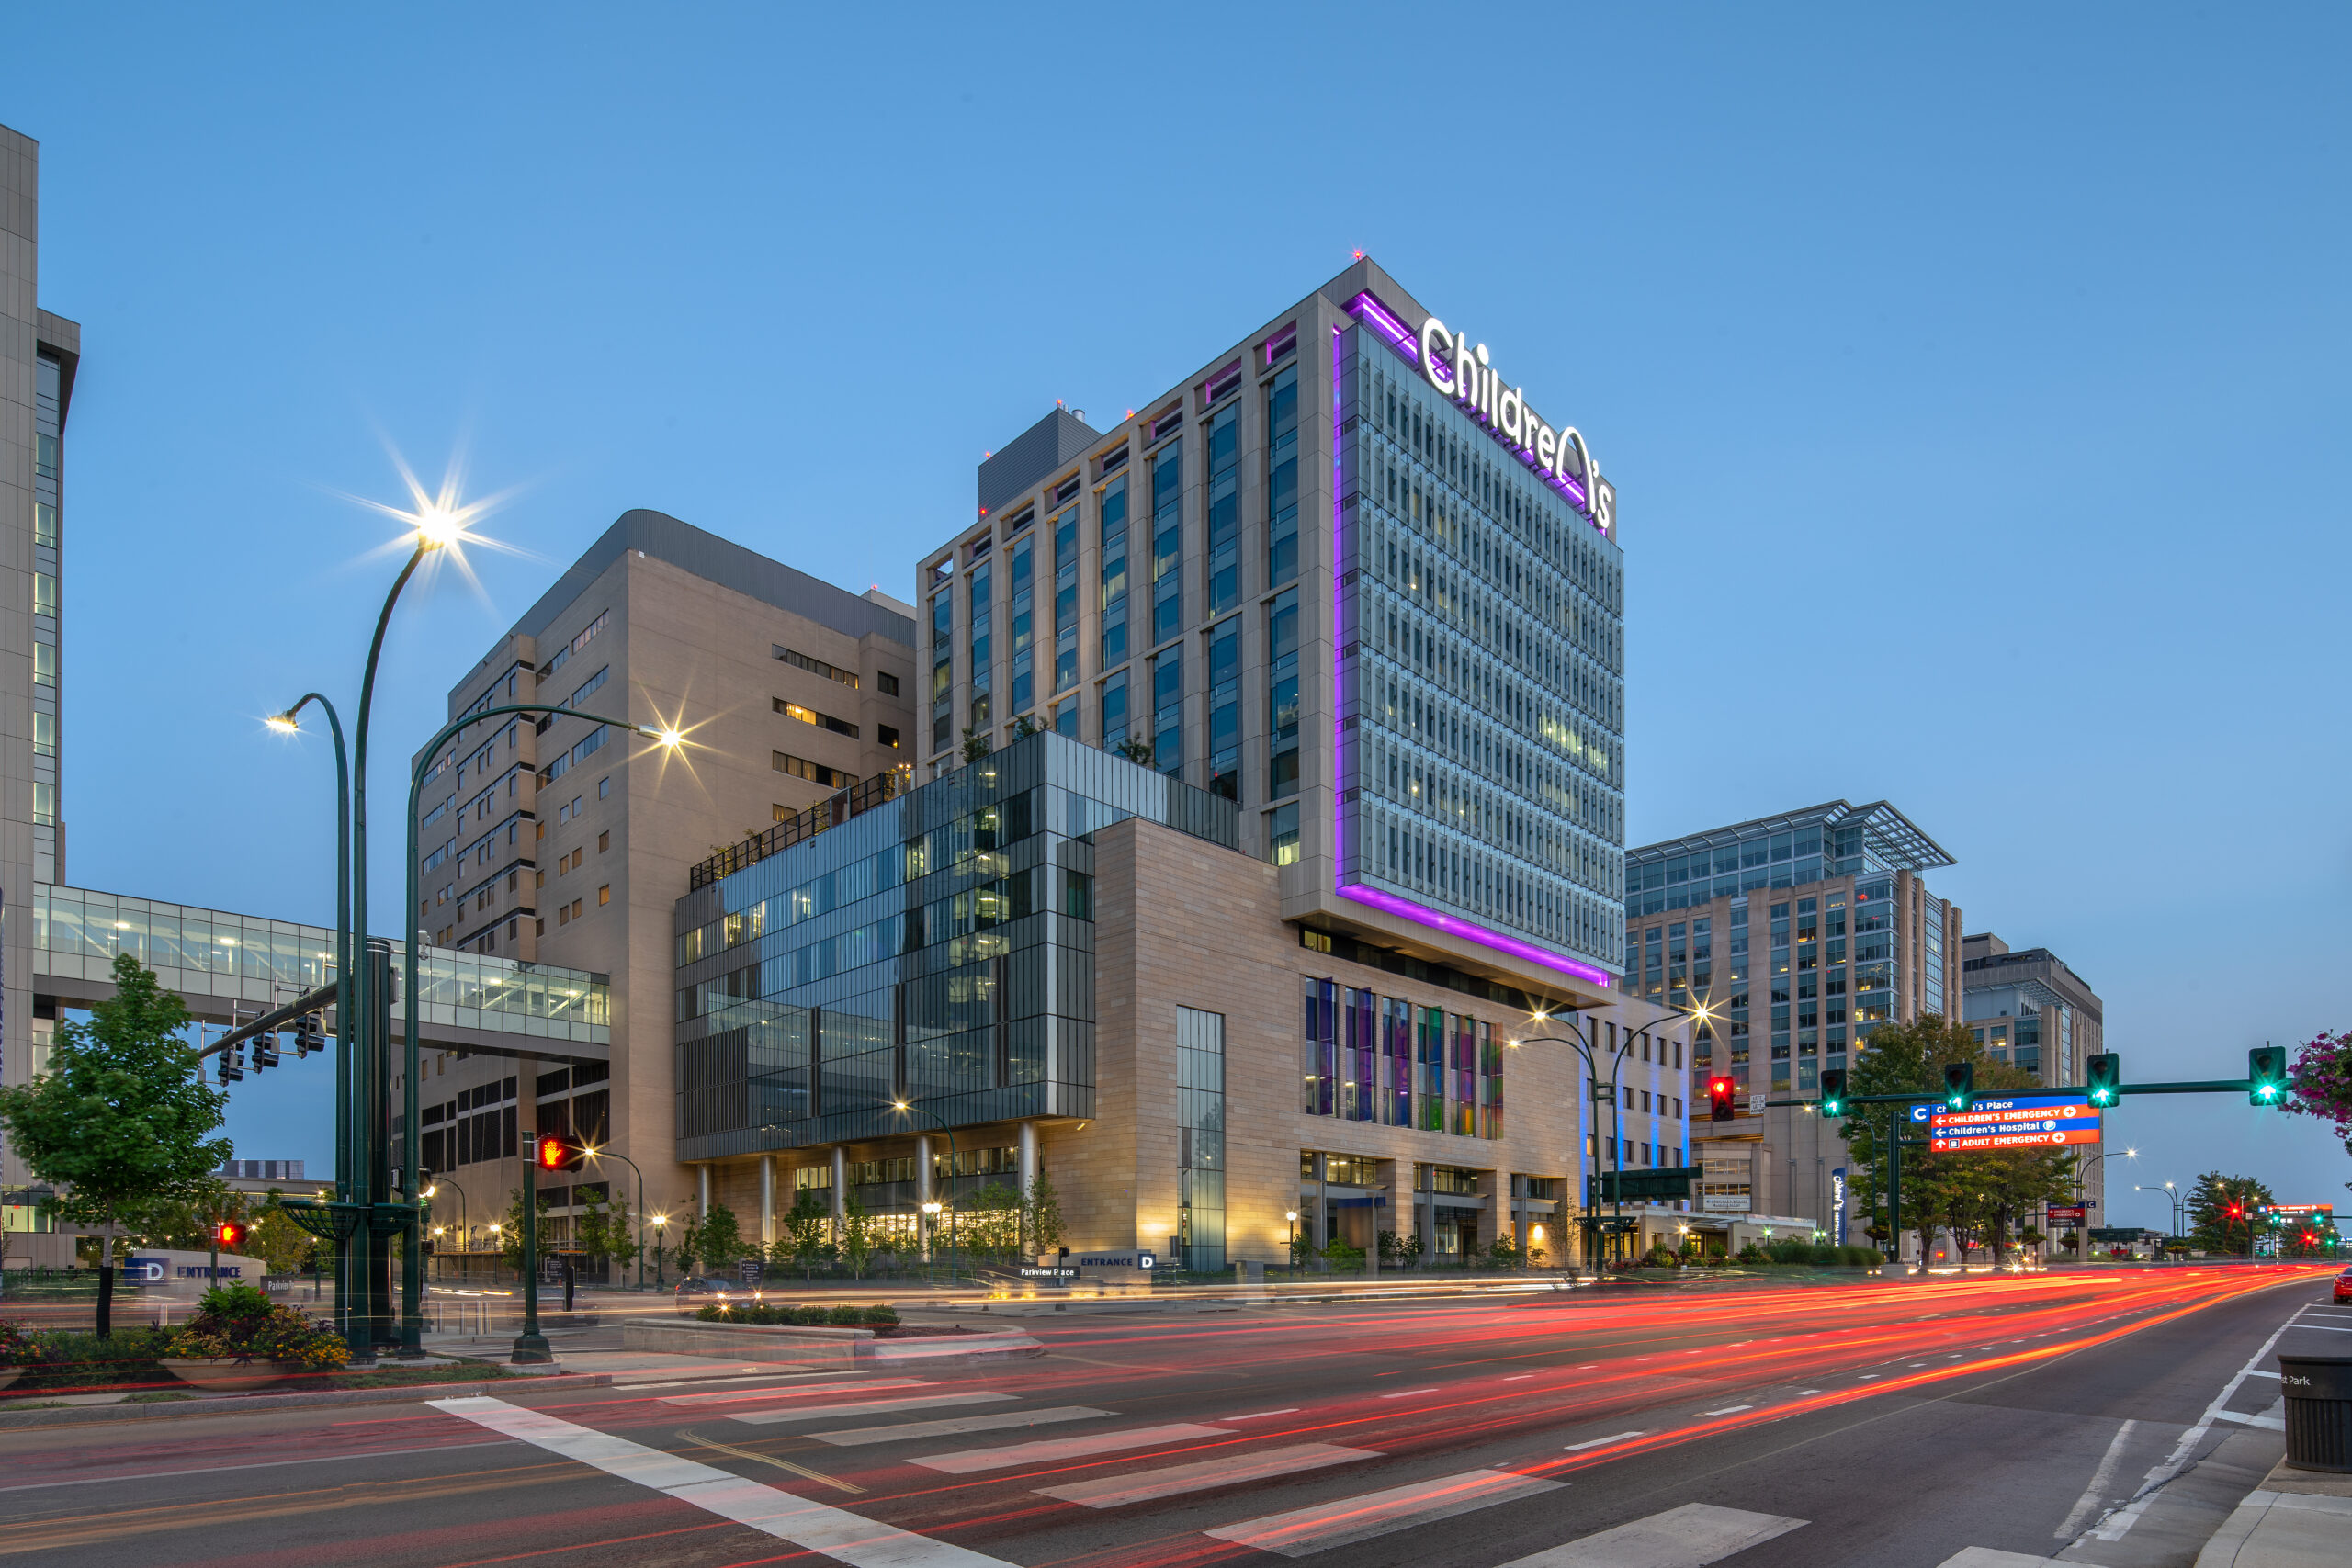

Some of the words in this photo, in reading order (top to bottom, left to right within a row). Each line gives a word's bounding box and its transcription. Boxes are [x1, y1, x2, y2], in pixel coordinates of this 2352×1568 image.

[1417, 317, 1611, 530] Children's
[1986, 1101, 2014, 1111] Place
[1914, 1108, 1927, 1120] C
[1948, 1113, 2001, 1123] CHILDREN'S
[2004, 1110, 2061, 1120] EMERGENCY
[1948, 1125, 1996, 1135] Children's
[1999, 1122, 2040, 1133] Hospital
[1962, 1139, 1991, 1147] ADULT
[1994, 1135, 2050, 1145] EMERGENCY
[1081, 1258, 1133, 1267] ENTRANCE
[1141, 1256, 1153, 1268] D
[146, 1263, 164, 1280] D
[2289, 1375, 2311, 1385] Park
